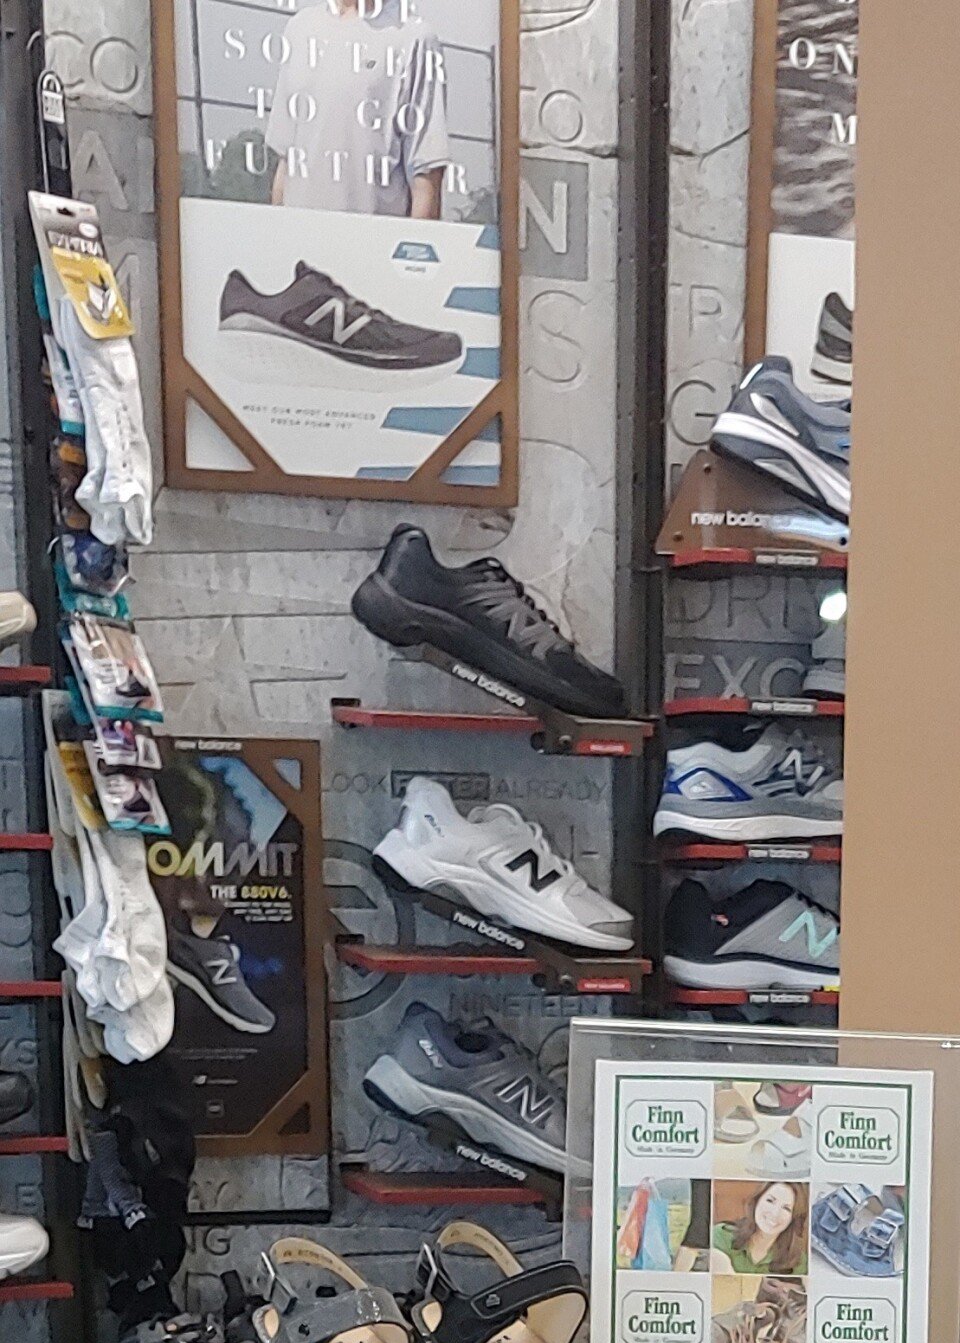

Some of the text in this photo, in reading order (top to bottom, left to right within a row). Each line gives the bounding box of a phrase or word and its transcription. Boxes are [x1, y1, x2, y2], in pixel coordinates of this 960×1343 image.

[224, 28, 446, 84] SOFTER
[248, 86, 425, 136] TO GO
[205, 138, 468, 194] FURTHR
[691, 512, 724, 526] new
[452, 664, 526, 708] new balance
[148, 840, 299, 877] OMMIT
[210, 885, 238, 899] THE
[453, 911, 526, 950] new balance
[648, 1106, 684, 1124] Finn
[840, 1112, 877, 1130] Finn
[631, 1124, 699, 1144] Comfort
[824, 1131, 892, 1150] Comfort
[457, 1145, 528, 1182] new balance
[644, 1298, 681, 1315] Finn
[836, 1304, 873, 1321] Finn
[628, 1315, 696, 1335] Comfort
[821, 1322, 889, 1341] Comfort
